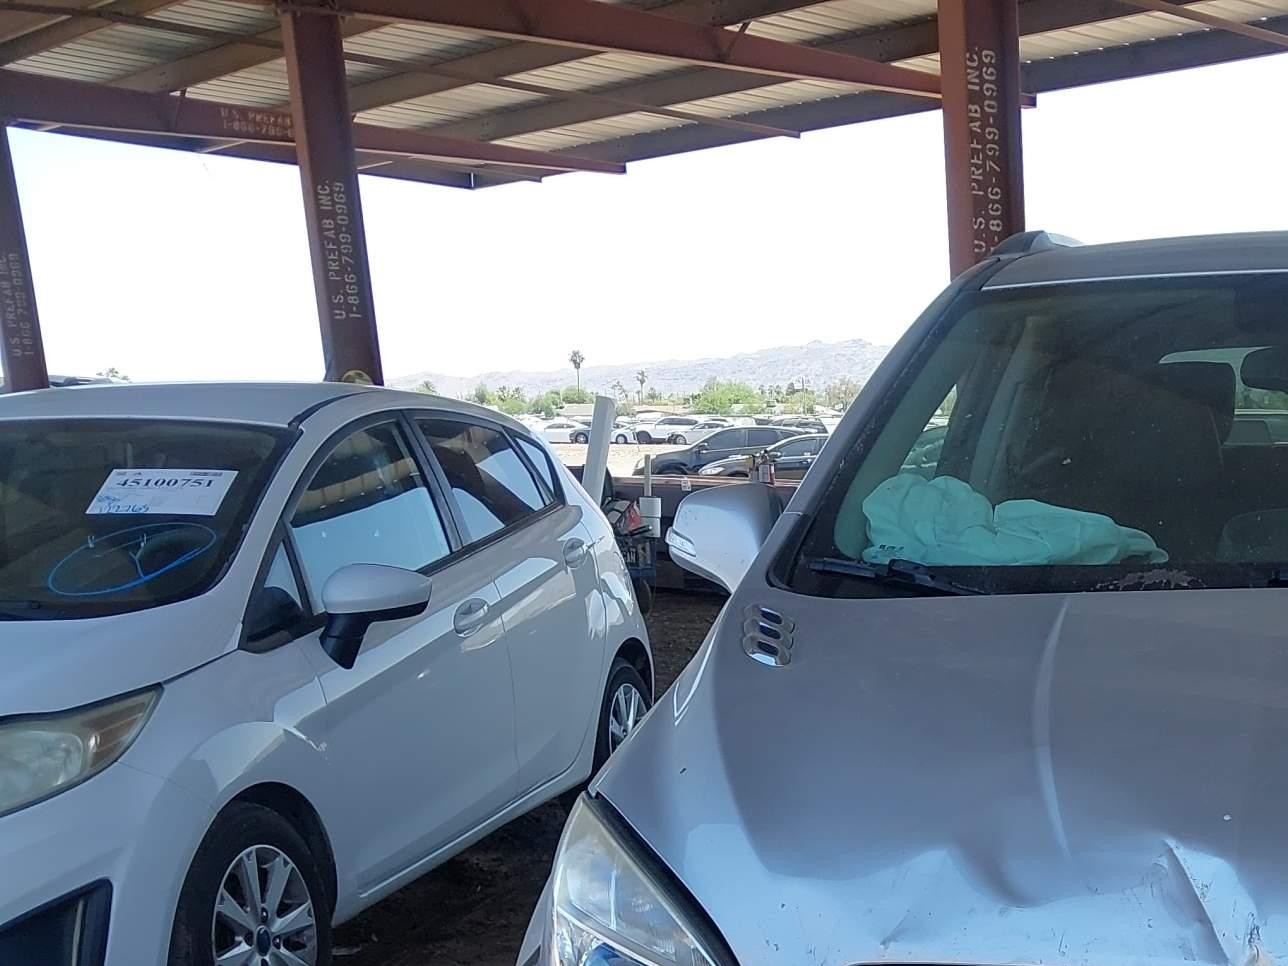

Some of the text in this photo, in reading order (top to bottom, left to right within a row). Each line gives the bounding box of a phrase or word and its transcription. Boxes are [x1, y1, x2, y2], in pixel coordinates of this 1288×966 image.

[966, 46, 987, 253] U.S. PREFAB INC.
[316, 180, 347, 320] U.S. PREFAB INC.
[333, 181, 362, 319] 1-866-799-0969
[116, 478, 215, 488] 45100751
